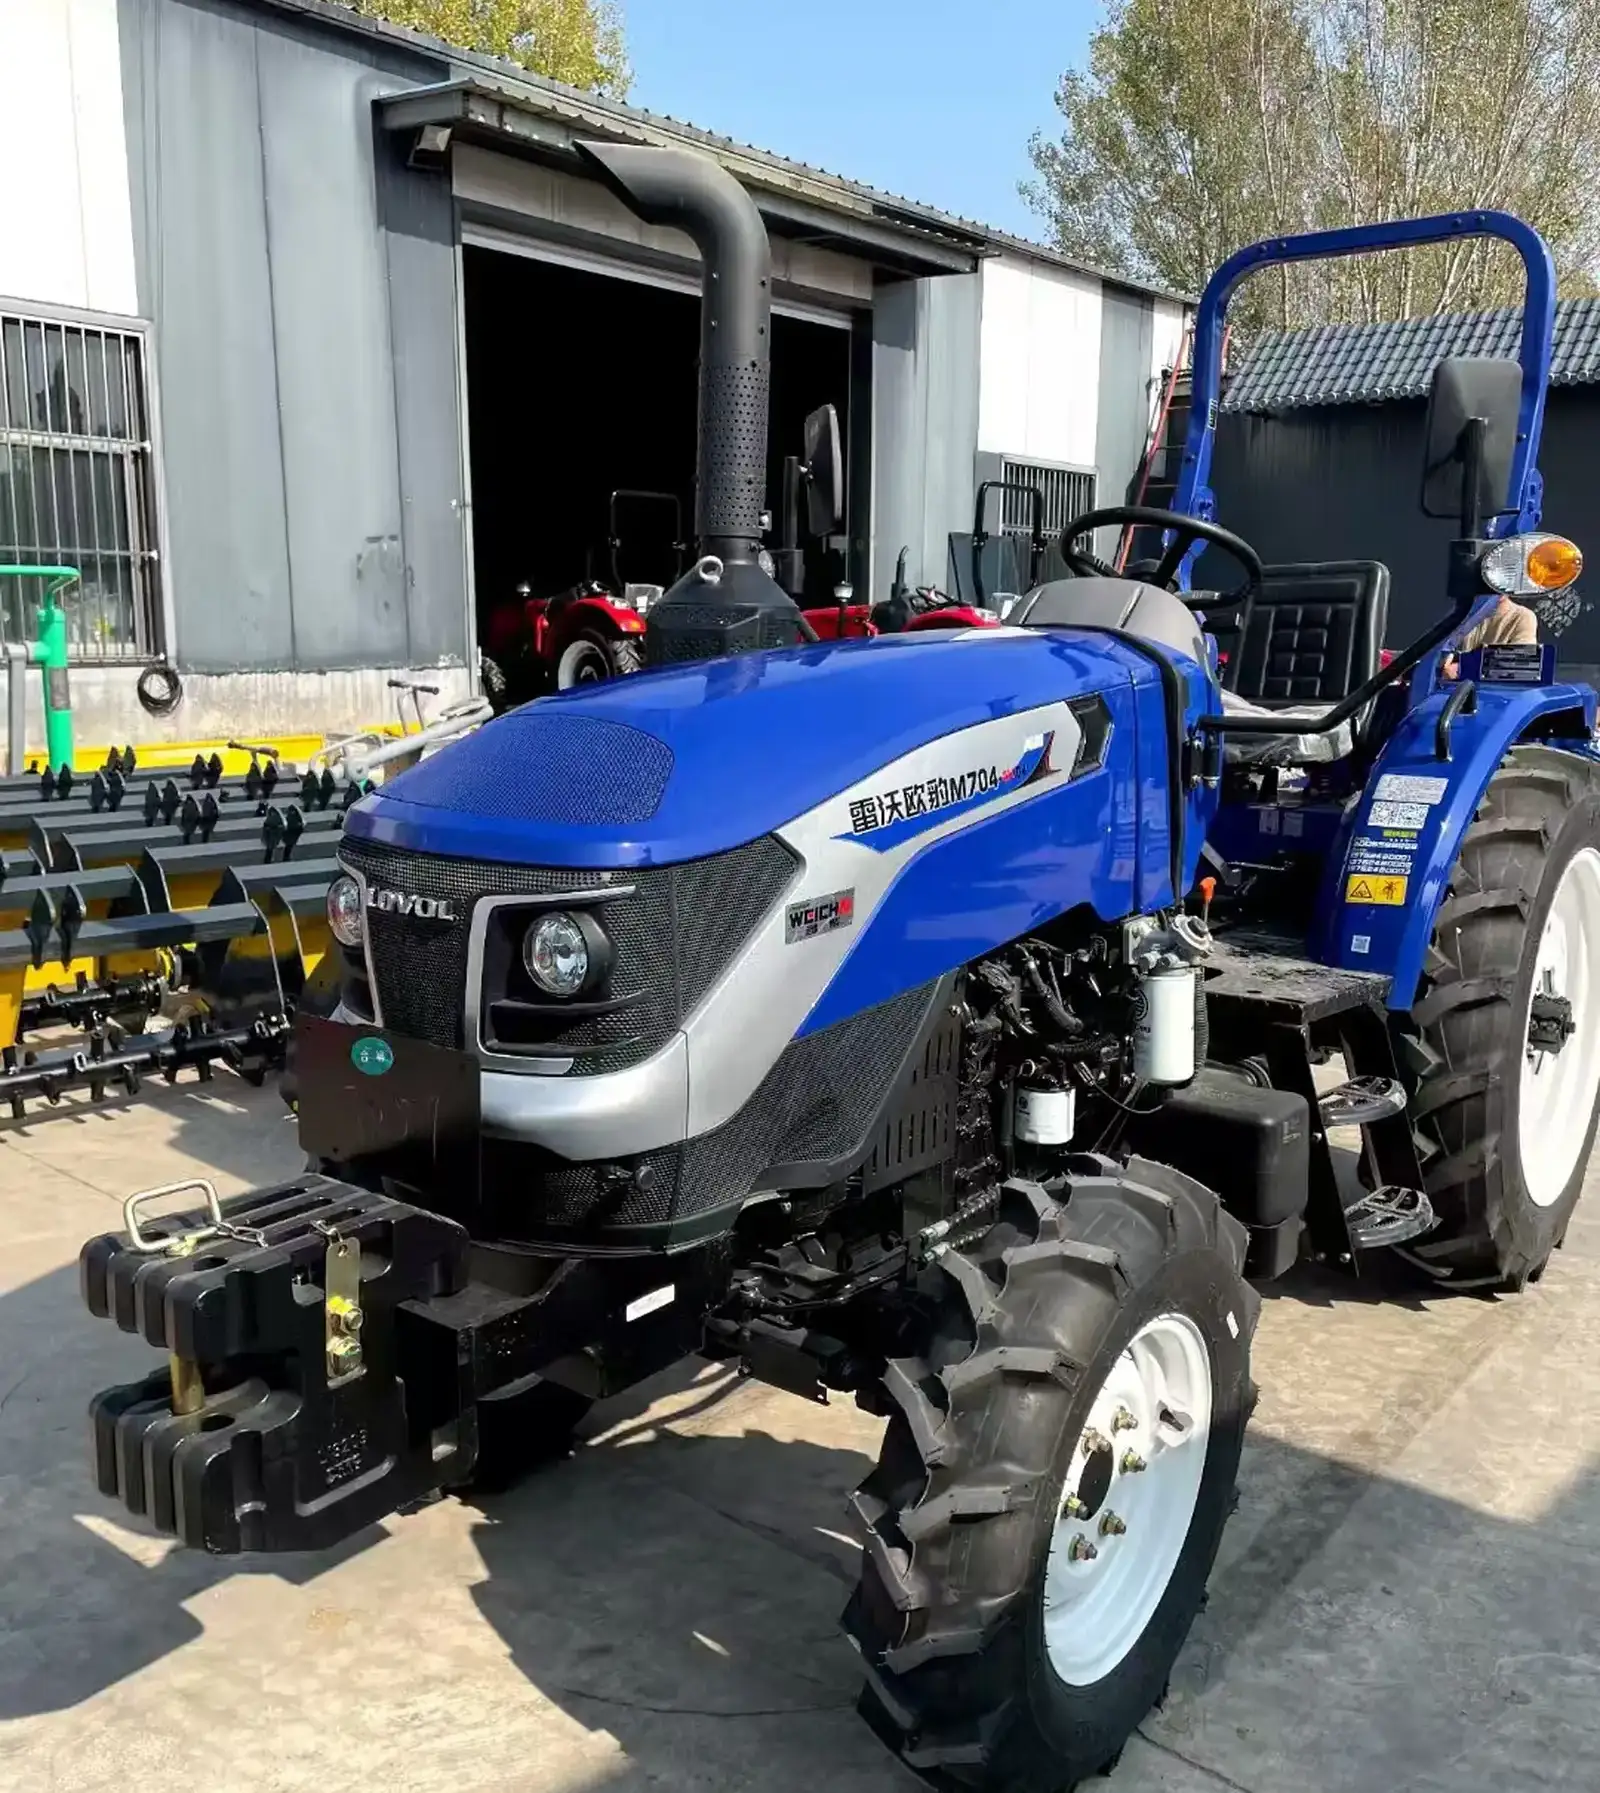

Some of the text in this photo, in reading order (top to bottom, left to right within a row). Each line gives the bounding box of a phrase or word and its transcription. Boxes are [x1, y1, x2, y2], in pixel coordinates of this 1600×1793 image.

[849, 766, 999, 833] 雷沃欧豹M704
[366, 887, 460, 921] LOVOL
